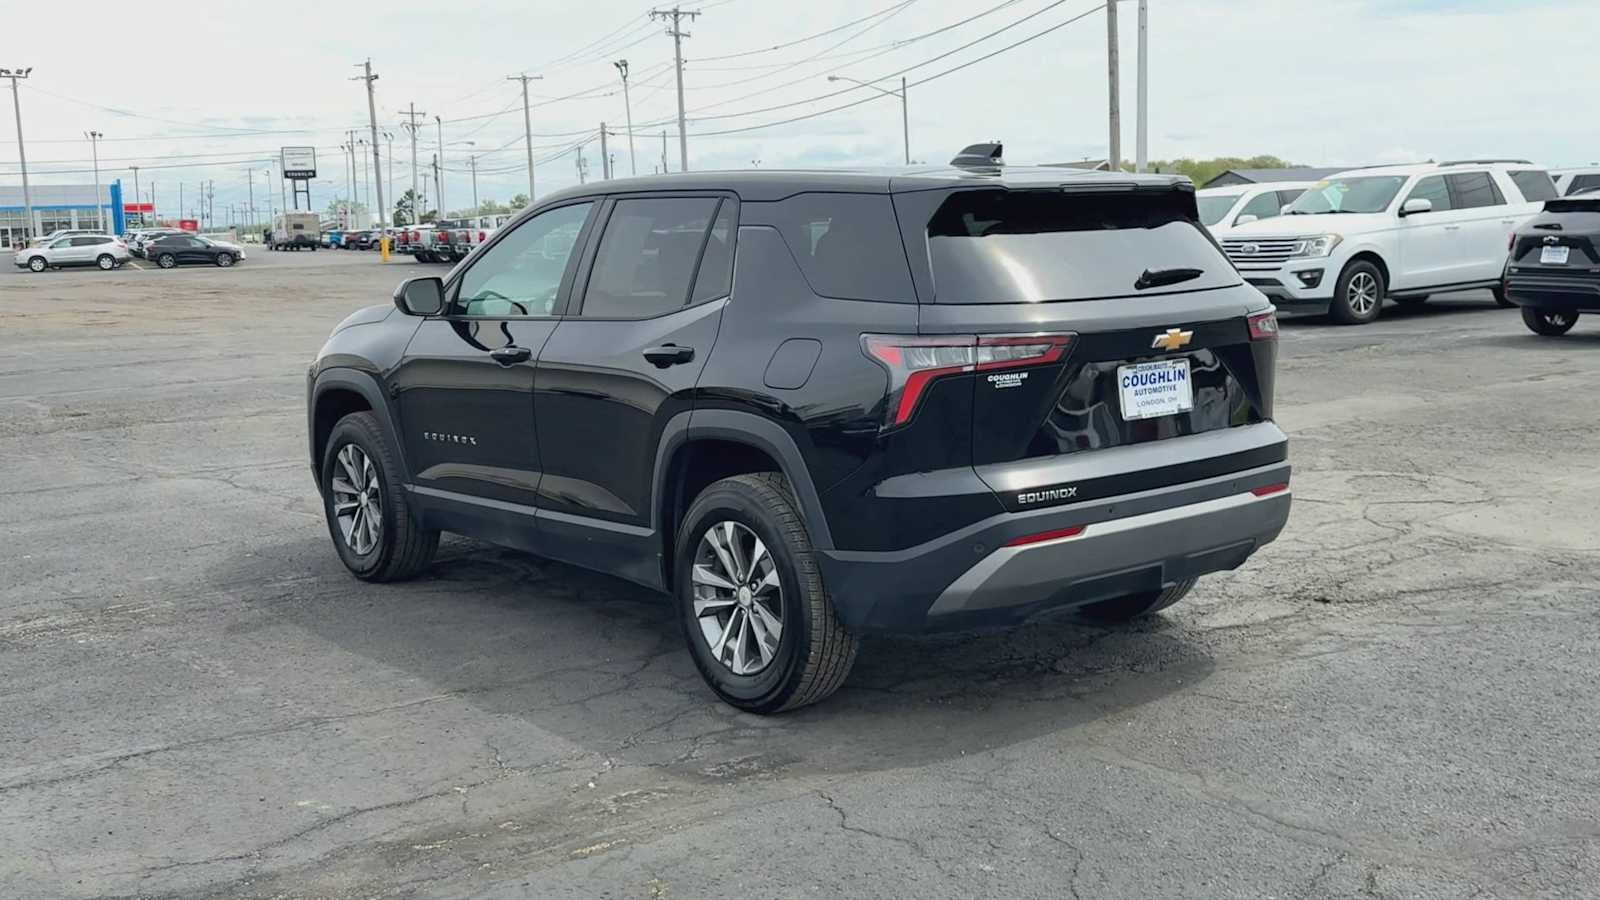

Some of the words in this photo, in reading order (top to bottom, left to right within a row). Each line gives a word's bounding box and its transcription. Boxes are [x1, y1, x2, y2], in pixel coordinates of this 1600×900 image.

[987, 371, 1029, 382] COUGHLIN
[1122, 369, 1186, 388] COUGHLIN
[1134, 384, 1177, 397] AUTOMOTIVE
[1017, 486, 1077, 505] EQUINOX
